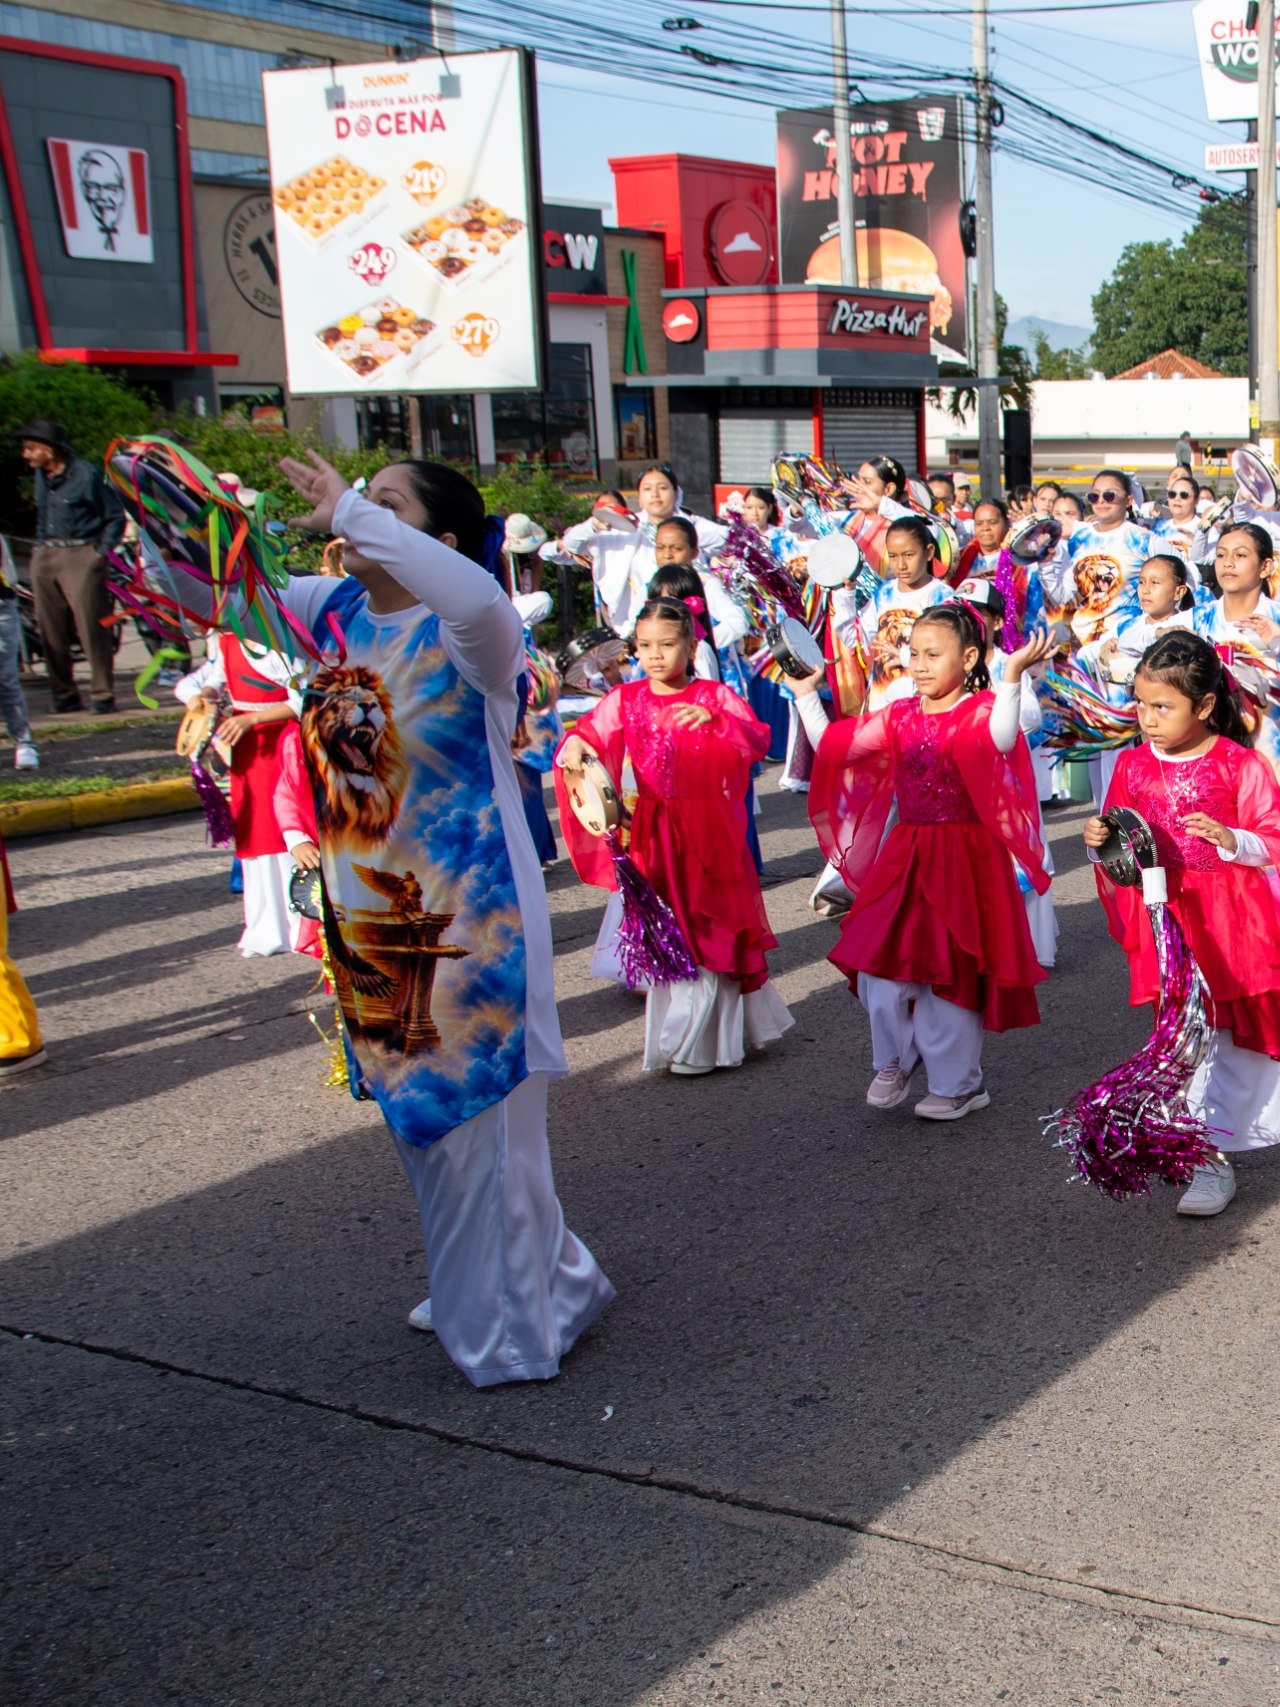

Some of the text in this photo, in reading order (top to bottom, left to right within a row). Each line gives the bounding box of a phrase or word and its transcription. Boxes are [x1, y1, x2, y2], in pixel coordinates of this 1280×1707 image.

[1217, 41, 1279, 67] WO
[335, 109, 446, 139] DOCENA
[830, 299, 928, 337] Pizza Hut
